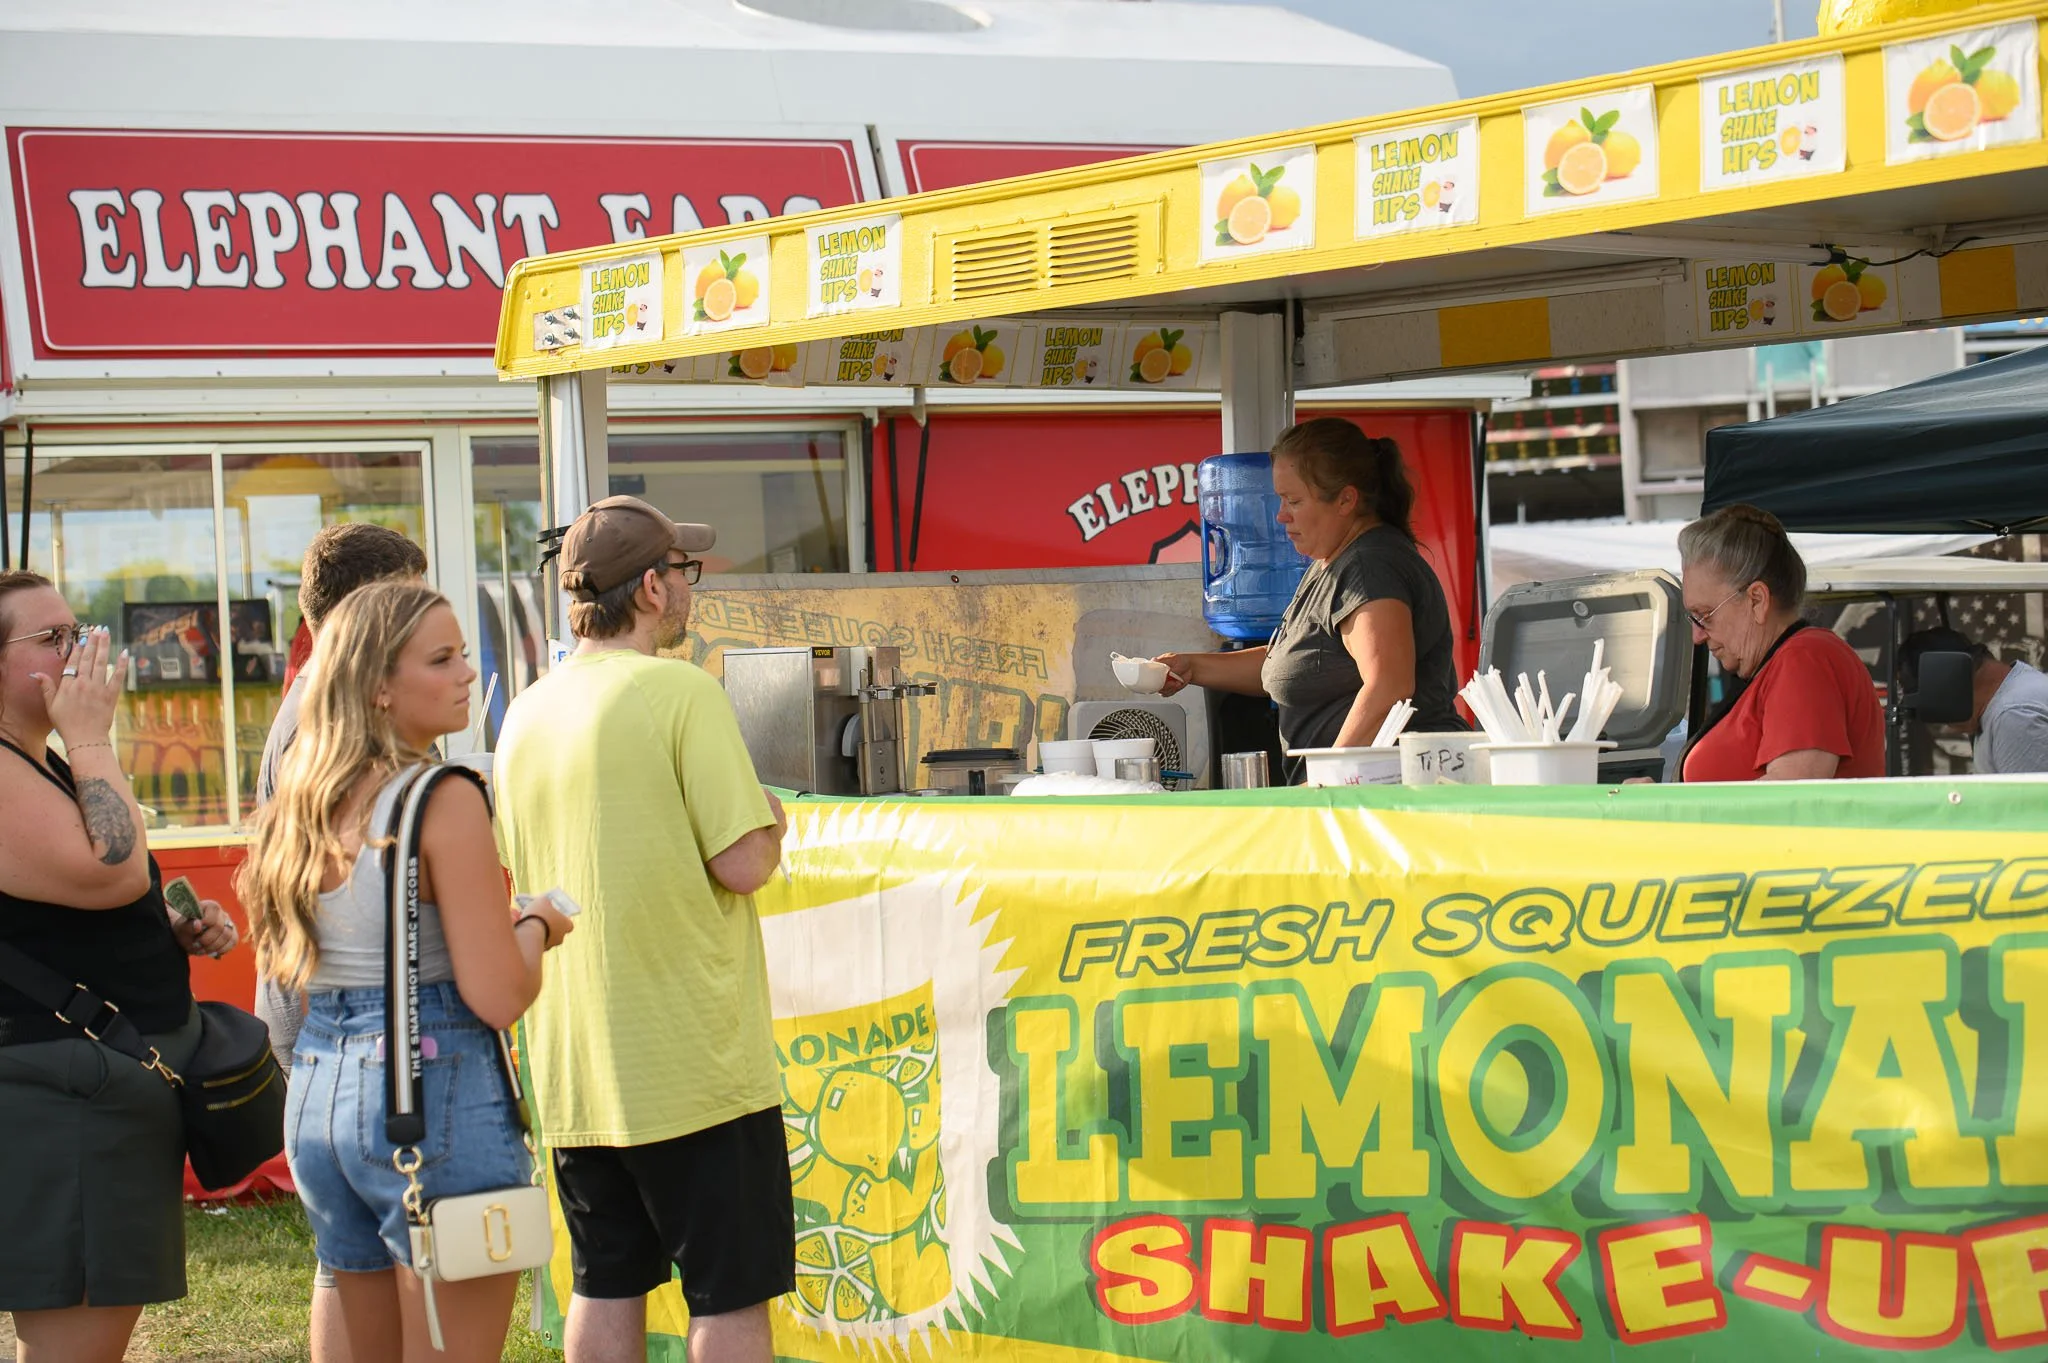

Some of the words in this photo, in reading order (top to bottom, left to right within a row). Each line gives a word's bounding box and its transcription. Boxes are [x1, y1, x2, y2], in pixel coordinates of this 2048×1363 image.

[1719, 70, 1820, 115] LEMON
[1721, 109, 1777, 144] SHAKE
[1370, 131, 1459, 171] LEMON
[1722, 142, 1777, 175] UPS
[1372, 166, 1421, 196] SHAKE
[1372, 194, 1421, 225] UPS
[67, 187, 561, 291] ELEPHANT
[818, 225, 886, 257] LEMON
[591, 261, 650, 294] LEMON
[820, 254, 858, 280] SHAKE
[1706, 262, 1775, 290] LEMON
[592, 295, 625, 316] SHAKE
[820, 279, 857, 304] UPS
[1708, 286, 1748, 308] SHAKE
[593, 313, 625, 339] UPS
[1710, 306, 1749, 332] UPS
[840, 341, 877, 360] SHAKE
[1044, 327, 1103, 348] LEMON
[837, 361, 873, 382] UPS
[1044, 347, 1077, 366] SHAKE
[1041, 365, 1074, 387] UPS
[407, 856, 419, 918] JACOBS
[407, 922, 419, 961] MARC
[1059, 898, 1395, 983] FRESH
[408, 967, 420, 1046] SNAPSHOT
[410, 1049, 422, 1080] THE
